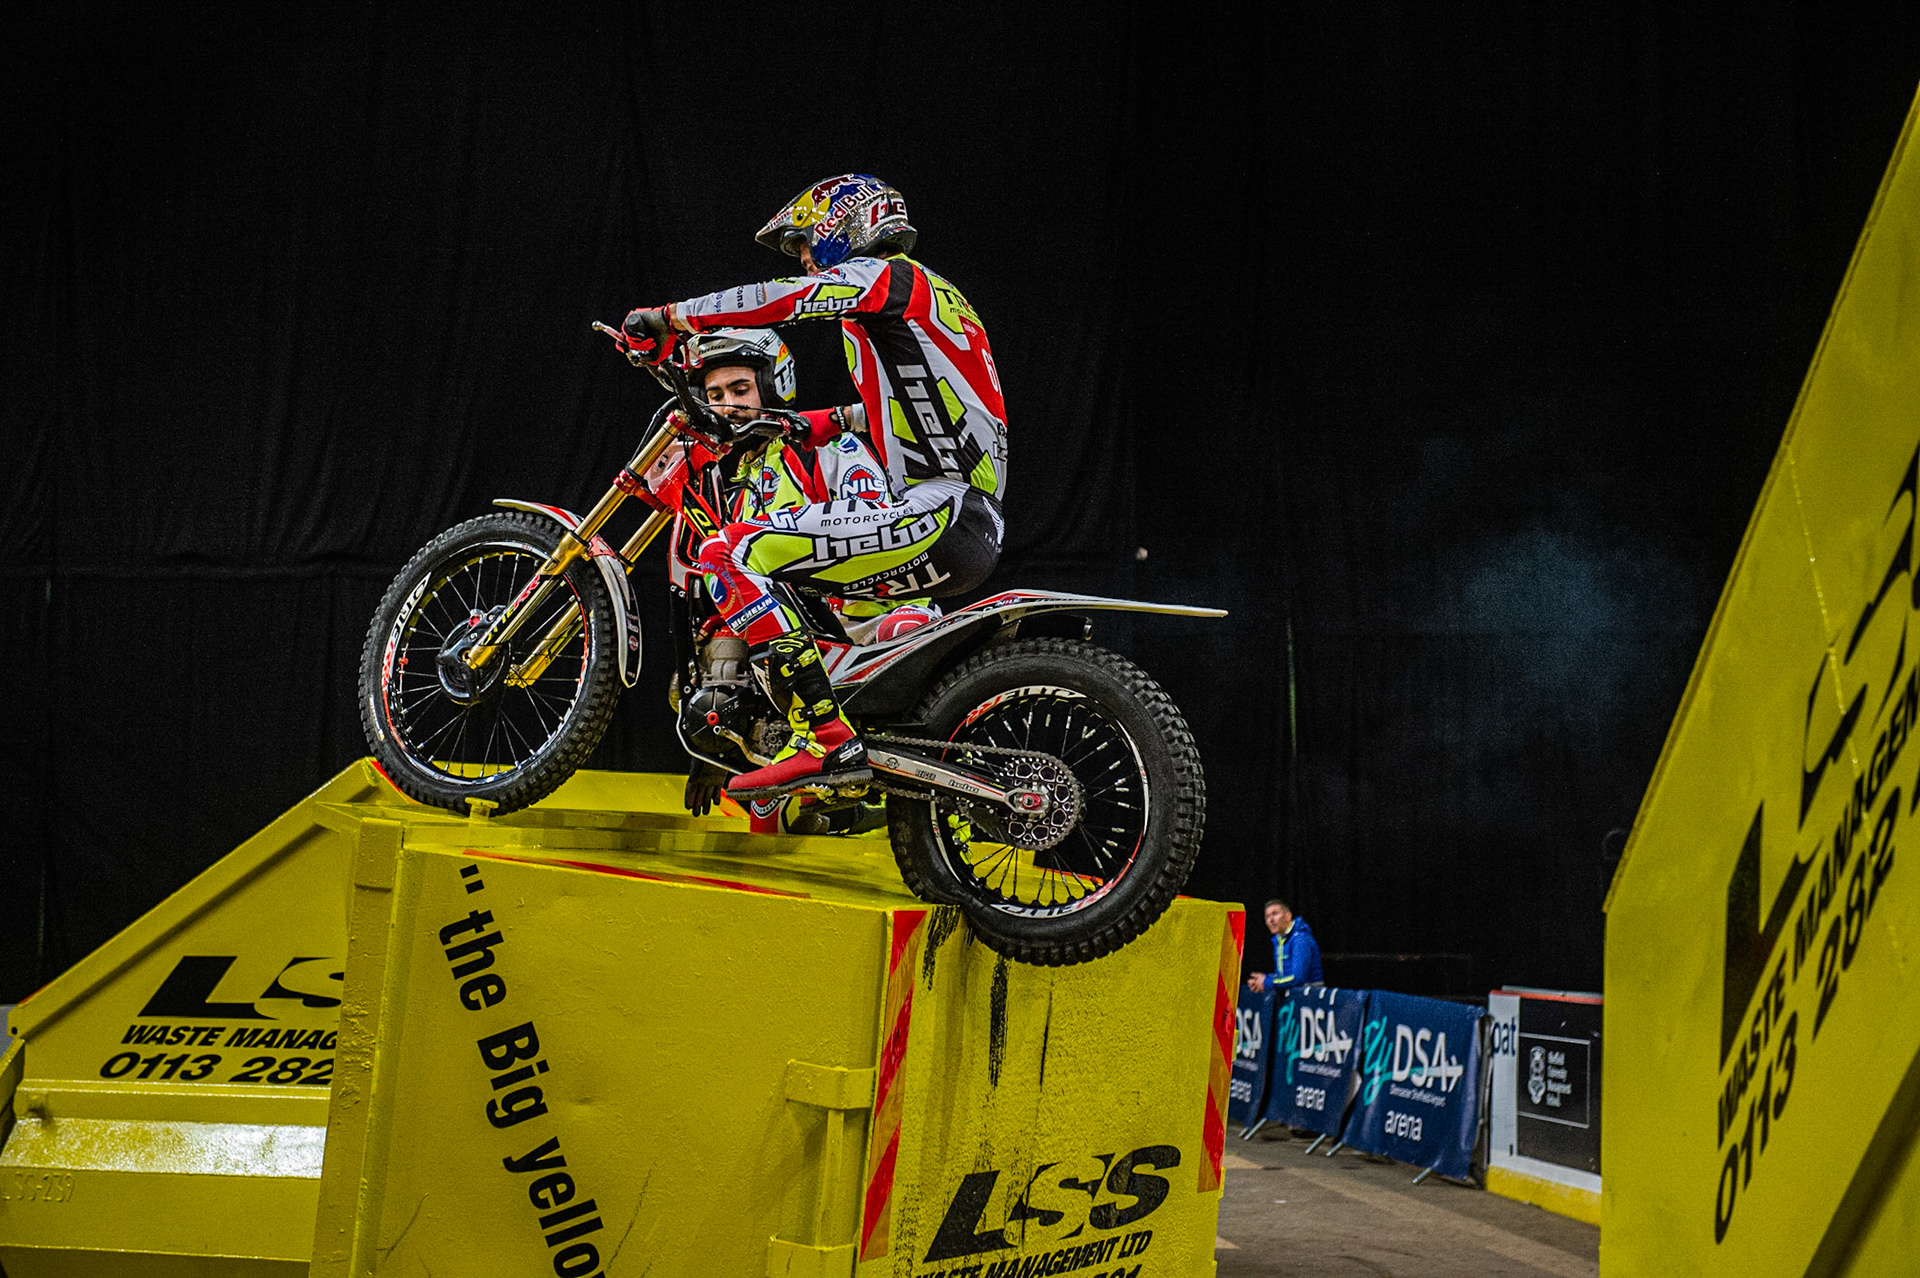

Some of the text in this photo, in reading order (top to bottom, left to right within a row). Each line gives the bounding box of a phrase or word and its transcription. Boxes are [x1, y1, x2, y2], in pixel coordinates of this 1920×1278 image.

[813, 202, 848, 240] Red
[840, 184, 876, 211] Bull
[794, 297, 859, 315] hebo
[841, 477, 886, 500] NILS
[814, 513, 939, 561] hebo
[731, 597, 773, 629] MICHELIN
[438, 909, 507, 1012] the
[121, 1024, 227, 1047] WASTE
[1300, 1007, 1342, 1064] DSA
[1714, 785, 1901, 1245] 0113 282
[100, 1052, 335, 1085] 0113 282
[477, 1021, 550, 1129] Big
[1392, 1024, 1449, 1092] DSA
[1718, 948, 1787, 1152] WASTE
[1296, 1085, 1326, 1111] arena
[1384, 1109, 1422, 1141] arena
[502, 1136, 605, 1278] yello
[922, 1145, 1181, 1264] LSS
[984, 1235, 1120, 1278] MANAGEMENT
[1117, 1229, 1153, 1260] LTD
